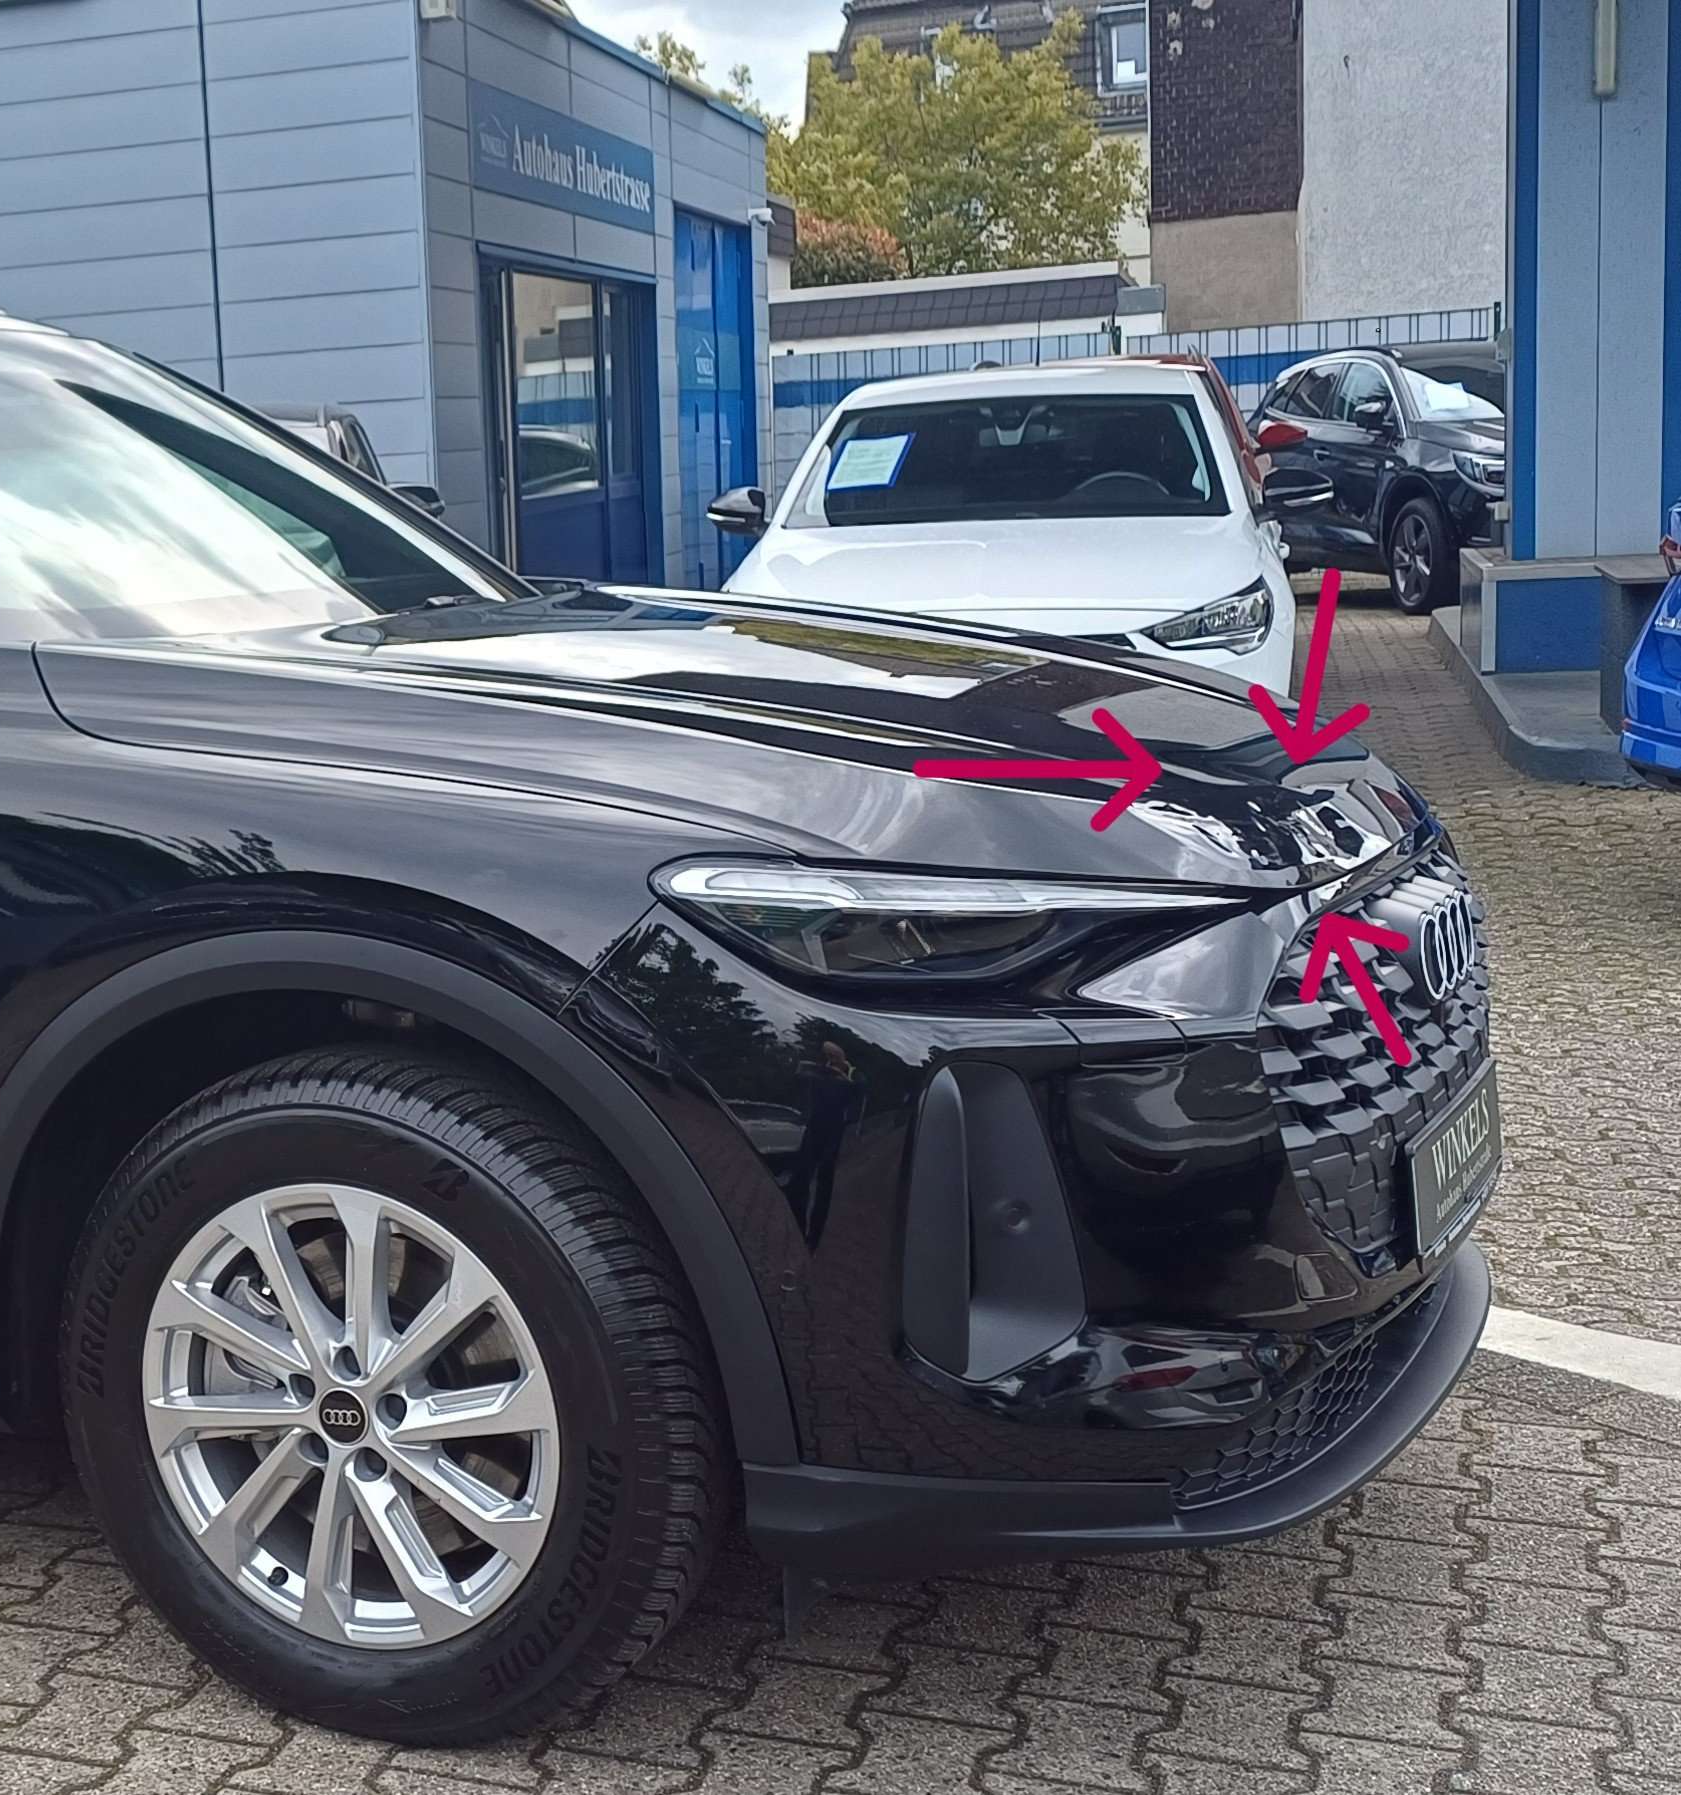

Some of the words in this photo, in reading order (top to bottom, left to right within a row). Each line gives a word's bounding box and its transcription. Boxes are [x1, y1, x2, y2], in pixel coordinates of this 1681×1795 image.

[512, 124, 574, 190] Autohaus
[575, 144, 651, 214] Hubertstrasse
[1431, 1088, 1490, 1191] WINKELS
[77, 1153, 195, 1398] BRIDGESTONE
[480, 1443, 623, 1698] BRIDGESTONE
